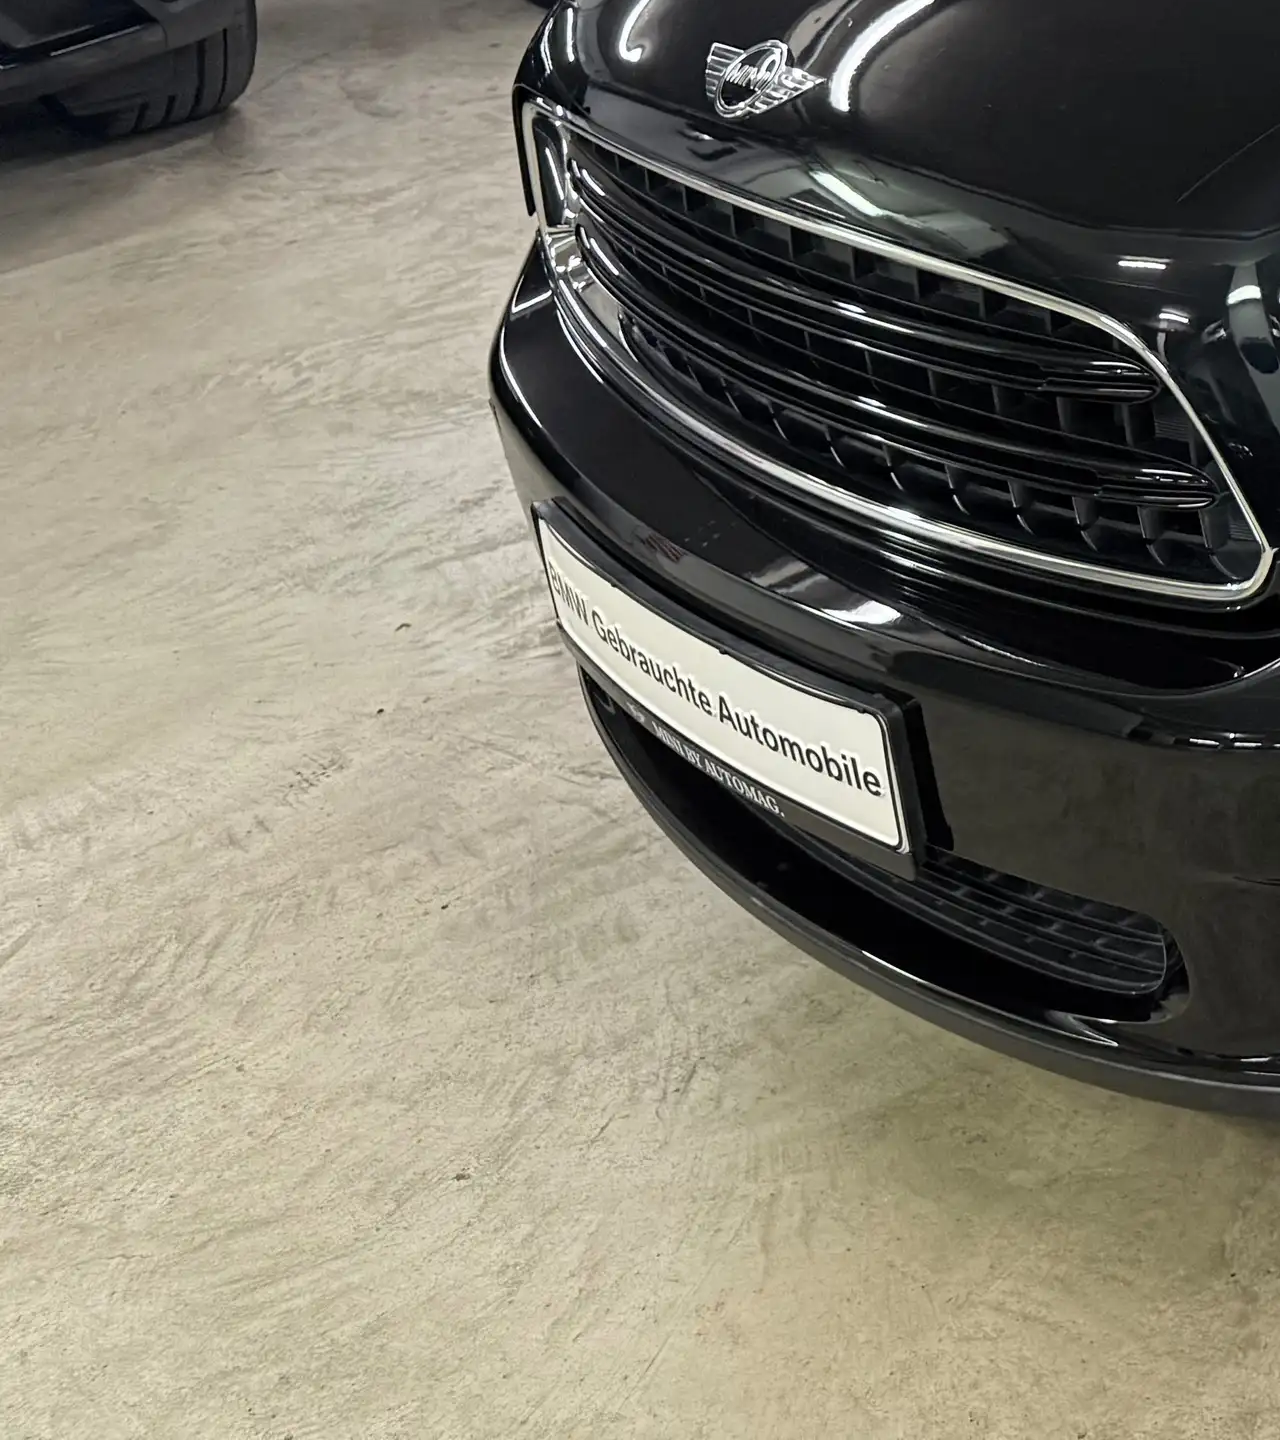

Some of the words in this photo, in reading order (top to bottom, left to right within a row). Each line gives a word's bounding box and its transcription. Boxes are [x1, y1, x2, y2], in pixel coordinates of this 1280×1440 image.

[549, 560, 589, 626] BMW
[592, 609, 712, 716] Gebrauchte
[719, 690, 881, 797] Automobile
[704, 758, 785, 818] AUTOMAG.
